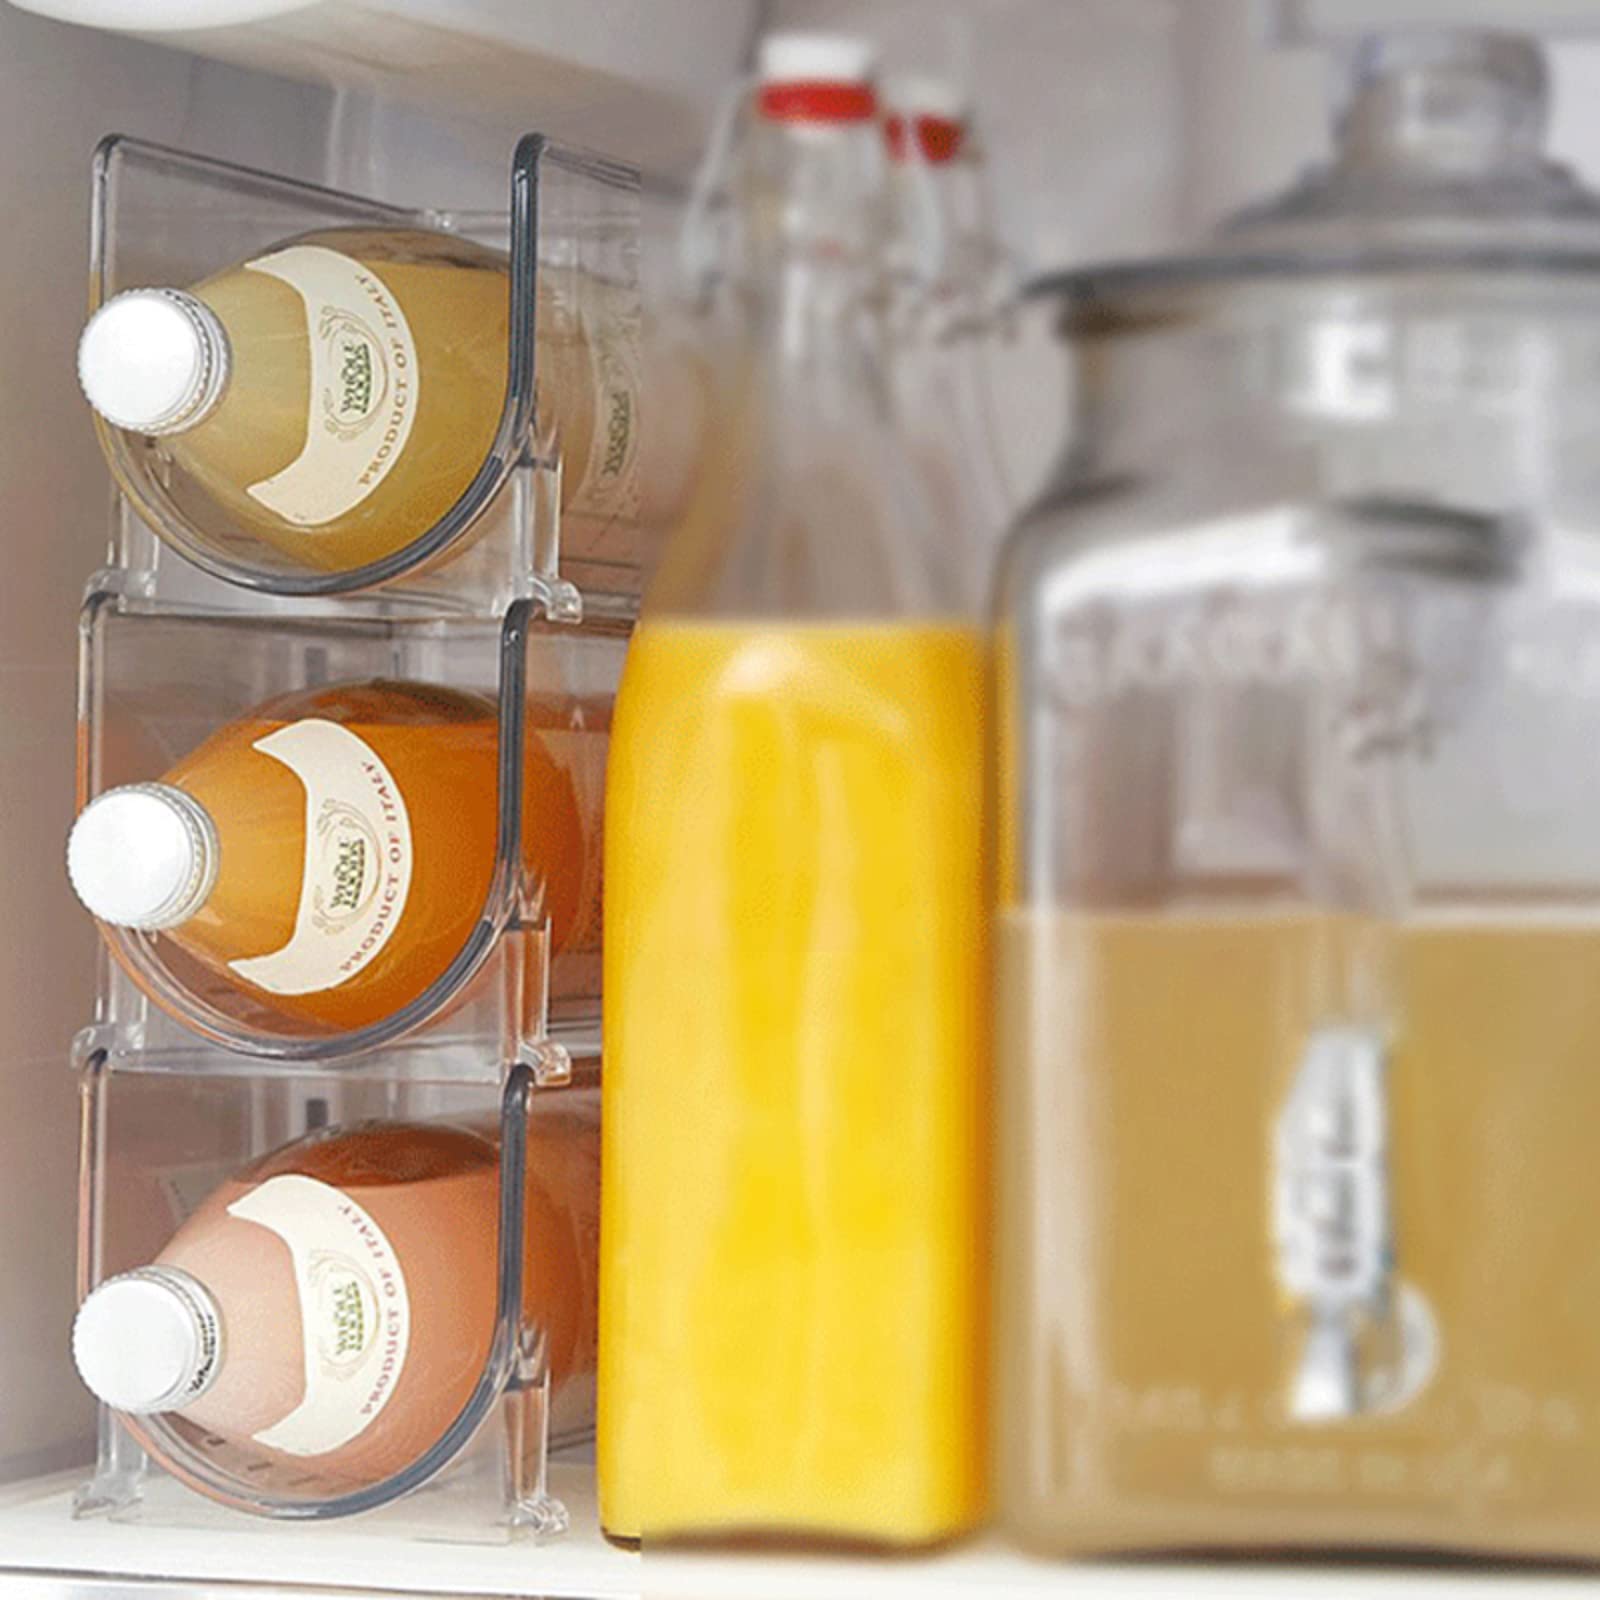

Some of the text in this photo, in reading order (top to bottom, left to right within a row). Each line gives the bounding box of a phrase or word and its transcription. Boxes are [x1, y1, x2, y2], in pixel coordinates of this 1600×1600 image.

[355, 273, 407, 486] PRODUCT OF ITALY
[340, 761, 401, 972] PRODUCT OF ITALY
[338, 1204, 399, 1415] PRODUCT OF ITALY
